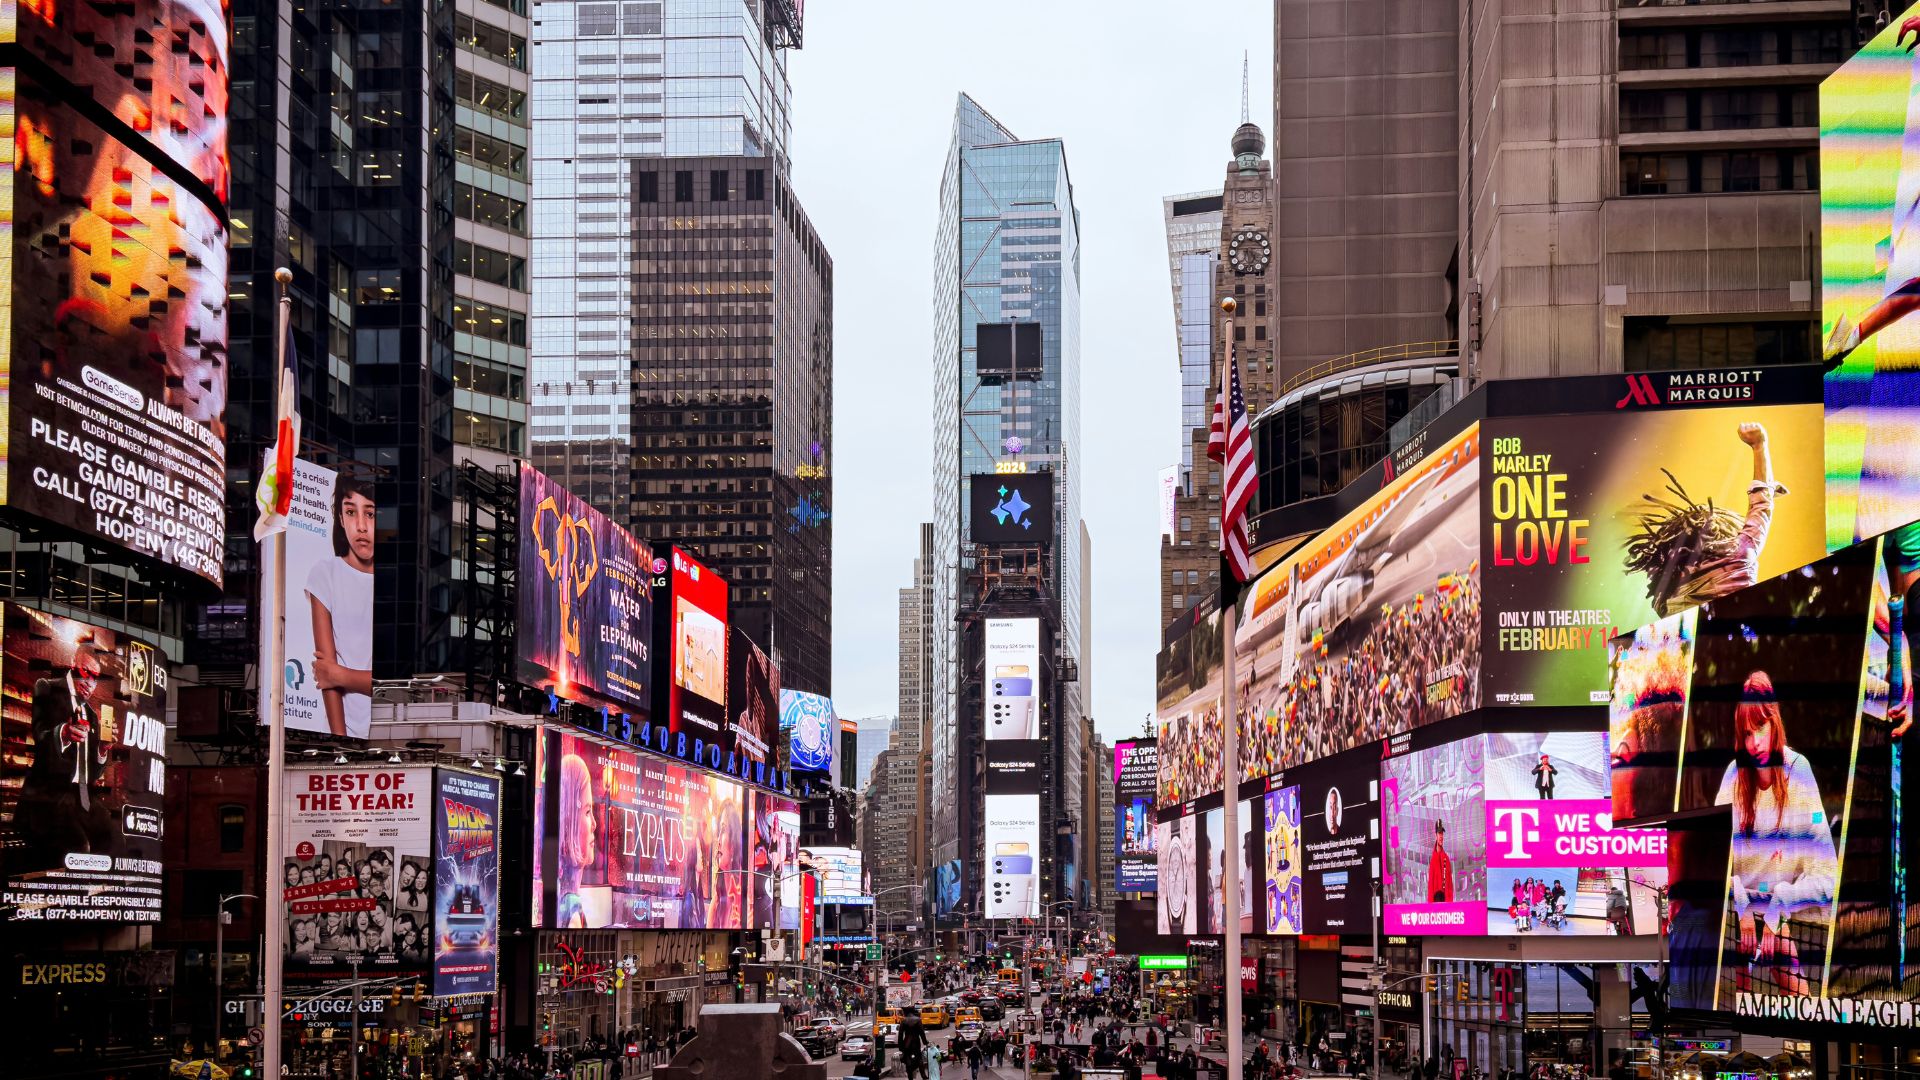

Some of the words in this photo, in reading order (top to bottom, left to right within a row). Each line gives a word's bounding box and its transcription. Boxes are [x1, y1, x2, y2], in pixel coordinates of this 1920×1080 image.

[1670, 371, 1762, 386] MARRIOTT
[86, 371, 140, 406] GameSense
[1670, 386, 1752, 401] MARQUIS
[35, 382, 56, 401] VISIT
[57, 393, 108, 425] BETMGM.COM
[108, 418, 124, 433] FOR
[124, 424, 148, 444] TERMS
[149, 436, 163, 451] AND
[147, 398, 182, 430] ALWAYS
[183, 416, 199, 439] BET
[81, 420, 106, 440] OLDER
[106, 431, 117, 444] TO
[117, 436, 143, 456] WAGER
[143, 448, 158, 463] AND
[1493, 438, 1521, 455] BOB
[32, 418, 107, 466] PLEASE
[111, 454, 183, 499] GAMBLE
[1493, 454, 1551, 473] MARLEY
[995, 462, 1026, 474] 2024
[308, 474, 329, 487] crisis
[79, 463, 175, 518] GAMBLING
[1492, 473, 1568, 520] ONE
[303, 495, 329, 511] health.
[33, 467, 85, 504] CALL
[90, 487, 214, 558] (877-8-HOPENY)
[304, 509, 327, 524] today.
[97, 513, 169, 555] HOPENY
[1493, 519, 1590, 567] LOVE
[680, 559, 687, 573] LG
[605, 567, 636, 590] FEBRUARY
[638, 585, 645, 597] 24
[652, 577, 666, 587] LG
[610, 588, 640, 621] WATER
[620, 619, 630, 630] FOR
[1499, 611, 1529, 627] ONLY
[1533, 610, 1545, 627] IN
[1548, 609, 1611, 626] THEATRES
[600, 624, 648, 662] ELEPHANTS
[1499, 627, 1592, 651] FEBRUARY
[1599, 626, 1619, 649] 14
[296, 695, 318, 708] Mind
[284, 707, 313, 719] stitute
[601, 706, 669, 752] 1540
[677, 731, 790, 795] BROADWAY
[1121, 747, 1137, 757] THE
[597, 756, 619, 770] NICOLE
[619, 761, 641, 775] KIDMAN
[1121, 756, 1132, 765] OF
[1133, 756, 1140, 765] A
[309, 774, 369, 792] BEST
[374, 772, 405, 790] OF
[457, 779, 468, 787] TIME
[473, 782, 490, 791] CHANGE
[442, 784, 460, 794] MUSICAL
[460, 787, 480, 797] THEATER
[657, 789, 672, 801] LULU
[296, 794, 342, 811] THE
[348, 792, 414, 810] YEAR!
[442, 796, 493, 829] BACK
[136, 819, 147, 833] App
[1554, 813, 1591, 832] WE
[623, 808, 686, 865] EXPATS
[1494, 808, 1539, 859] T
[68, 856, 110, 868] GameSense
[114, 857, 138, 873] ALWAYS
[341, 879, 353, 887] WE
[626, 871, 634, 881] WE
[634, 873, 643, 882] ARE
[644, 874, 656, 884] WHAT
[657, 875, 664, 884] WE
[283, 884, 331, 898] ERRILY
[3, 892, 45, 905] PLEASE
[46, 894, 89, 907] GAMBLE
[91, 895, 146, 908] RESPONSIBLY.
[335, 901, 371, 909] ALONG
[16, 908, 43, 920] CALL
[46, 907, 122, 921] (877-8-HOPENY)
[123, 910, 134, 921] OR
[135, 910, 150, 921] TEXT
[1401, 912, 1411, 925] WE
[1418, 912, 1430, 925] OUR
[1430, 911, 1465, 925] CUSTOMERS
[655, 931, 700, 964] FOREVER
[1388, 936, 1407, 944] SEPHORA
[22, 963, 106, 985] EXPRESS
[294, 1000, 384, 1013] LUGGAGE
[1378, 993, 1412, 1008] SEPHORA
[303, 1013, 319, 1021] NY
[1738, 992, 1843, 1023] AMERICAN
[1853, 1000, 1920, 1028] EAGLE
